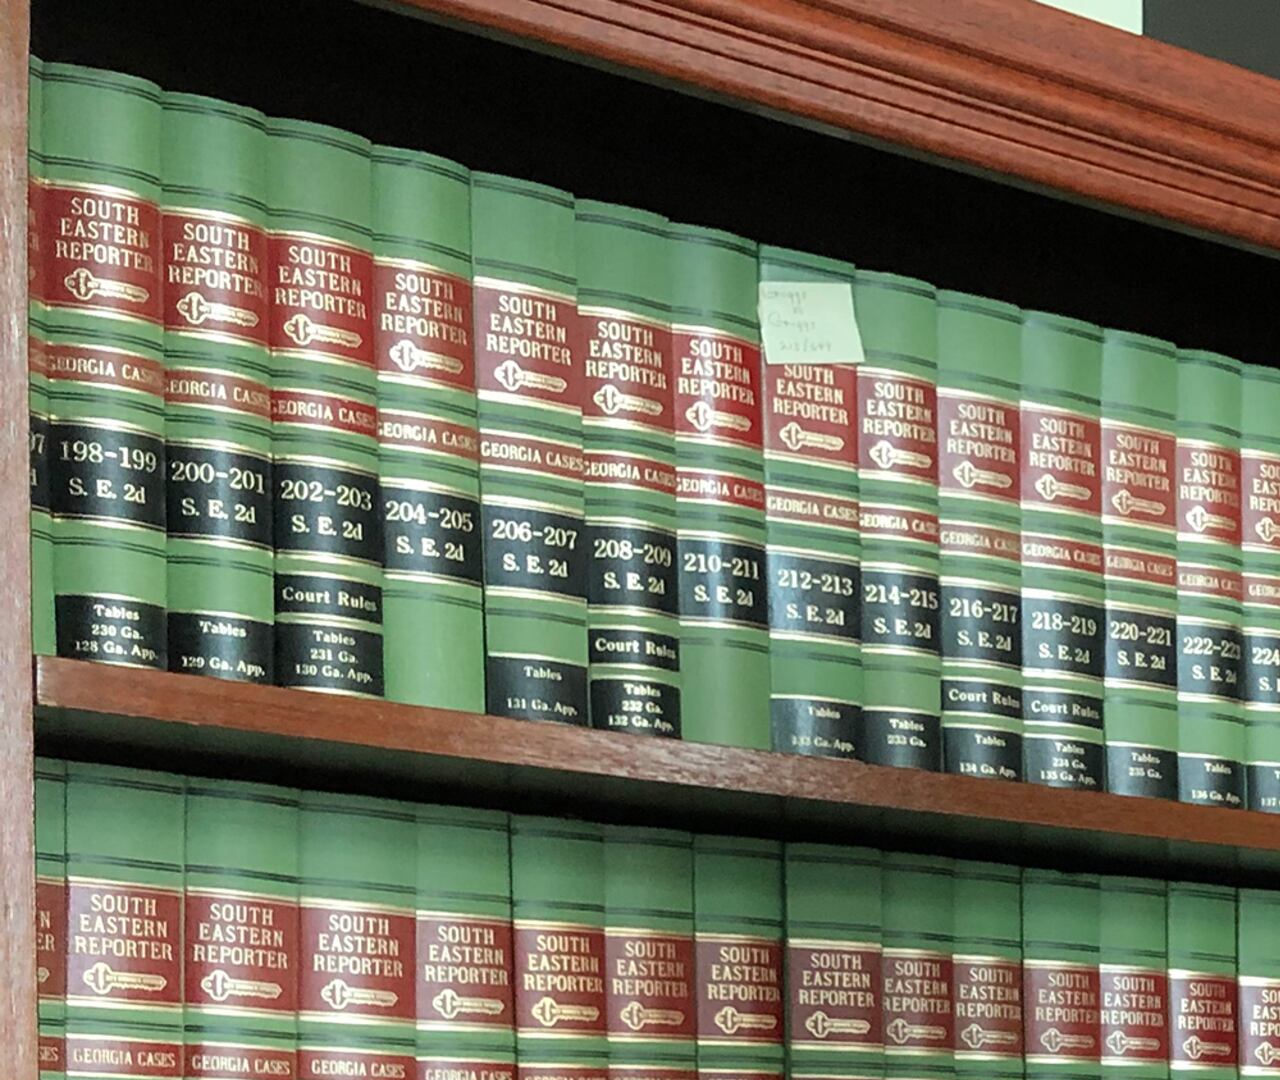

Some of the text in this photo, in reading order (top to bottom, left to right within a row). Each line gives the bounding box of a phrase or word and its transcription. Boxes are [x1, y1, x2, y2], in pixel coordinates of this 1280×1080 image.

[70, 197, 140, 224] SOUTH
[60, 217, 150, 249] EASTERN
[183, 222, 249, 250] SOUTH
[55, 240, 153, 273] REPORTER
[173, 242, 259, 273] EASTERN
[288, 246, 351, 273] SOUTH
[168, 265, 263, 297] REPORTER
[278, 266, 361, 295] EASTERN
[395, 273, 454, 300] SOUTH
[275, 288, 366, 320] REPORTER
[386, 292, 463, 323] EASTERN
[499, 295, 556, 321] SOUTH
[381, 313, 467, 345] REPORTER
[490, 315, 567, 342] EASTERN
[598, 321, 654, 345] SOUTH
[486, 334, 572, 366] REPORTER
[589, 340, 662, 367] EASTERN
[689, 339, 743, 364] SOUTH
[585, 361, 667, 389] REPORTER
[681, 357, 750, 384] EASTERN
[784, 364, 834, 385] SOUTH
[678, 378, 754, 405] REPORTER
[776, 381, 844, 405] EASTERN
[875, 381, 924, 405] SOUTH
[773, 398, 848, 426] REPORTER
[867, 398, 932, 423] EASTERN
[863, 418, 936, 443] REPORTER
[1116, 433, 1159, 454] SOUTH
[60, 441, 157, 472] 198-199
[481, 442, 583, 472] GEORGIA CASES
[1109, 449, 1166, 474] EASTERN
[172, 461, 265, 494] 200-201
[1106, 466, 1169, 491] REPORTER
[68, 477, 146, 504] S. E. 2d
[280, 480, 373, 511] 202-203
[385, 500, 473, 533] 204-205
[767, 496, 858, 522] GEORGIA CASES
[492, 520, 577, 551] 206-207
[594, 538, 672, 567] 208-209
[684, 552, 760, 580] 210-211
[778, 568, 853, 597] 212-213
[282, 587, 376, 612] Court Rules
[865, 583, 938, 610] 214-215
[94, 604, 140, 621] Tables
[950, 598, 1018, 625] 216-217
[1032, 610, 1096, 637] 218-219
[121, 625, 143, 640] Ga.
[1110, 620, 1172, 647] 220-221
[596, 637, 639, 654] Court
[90, 894, 157, 916] SOUTH
[210, 903, 273, 926] SOUTH
[80, 914, 168, 937] EASTERN
[199, 922, 283, 947] EASTERN
[329, 914, 389, 935] SOUTH
[438, 925, 495, 945] SOUTH
[75, 935, 173, 960] REPORTER
[193, 942, 288, 968] REPORTER
[318, 934, 398, 956] EASTERN
[429, 943, 503, 966] EASTERN
[537, 935, 590, 954] SOUTH
[625, 941, 676, 959] SOUTH
[313, 954, 403, 977] REPORTER
[425, 963, 508, 986] REPORTER
[528, 953, 599, 973] EASTERN
[617, 960, 684, 978] EASTERN
[811, 953, 862, 971] SOUTH
[524, 972, 603, 993] REPORTER
[612, 979, 688, 997] REPORTER
[803, 970, 871, 989] EASTERN
[799, 989, 874, 1007] REPORTER
[73, 1047, 175, 1067] GEORGIA CASES
[192, 1054, 290, 1075] GEORGIA CASES
[312, 1058, 405, 1078] GEORGIA CASES
